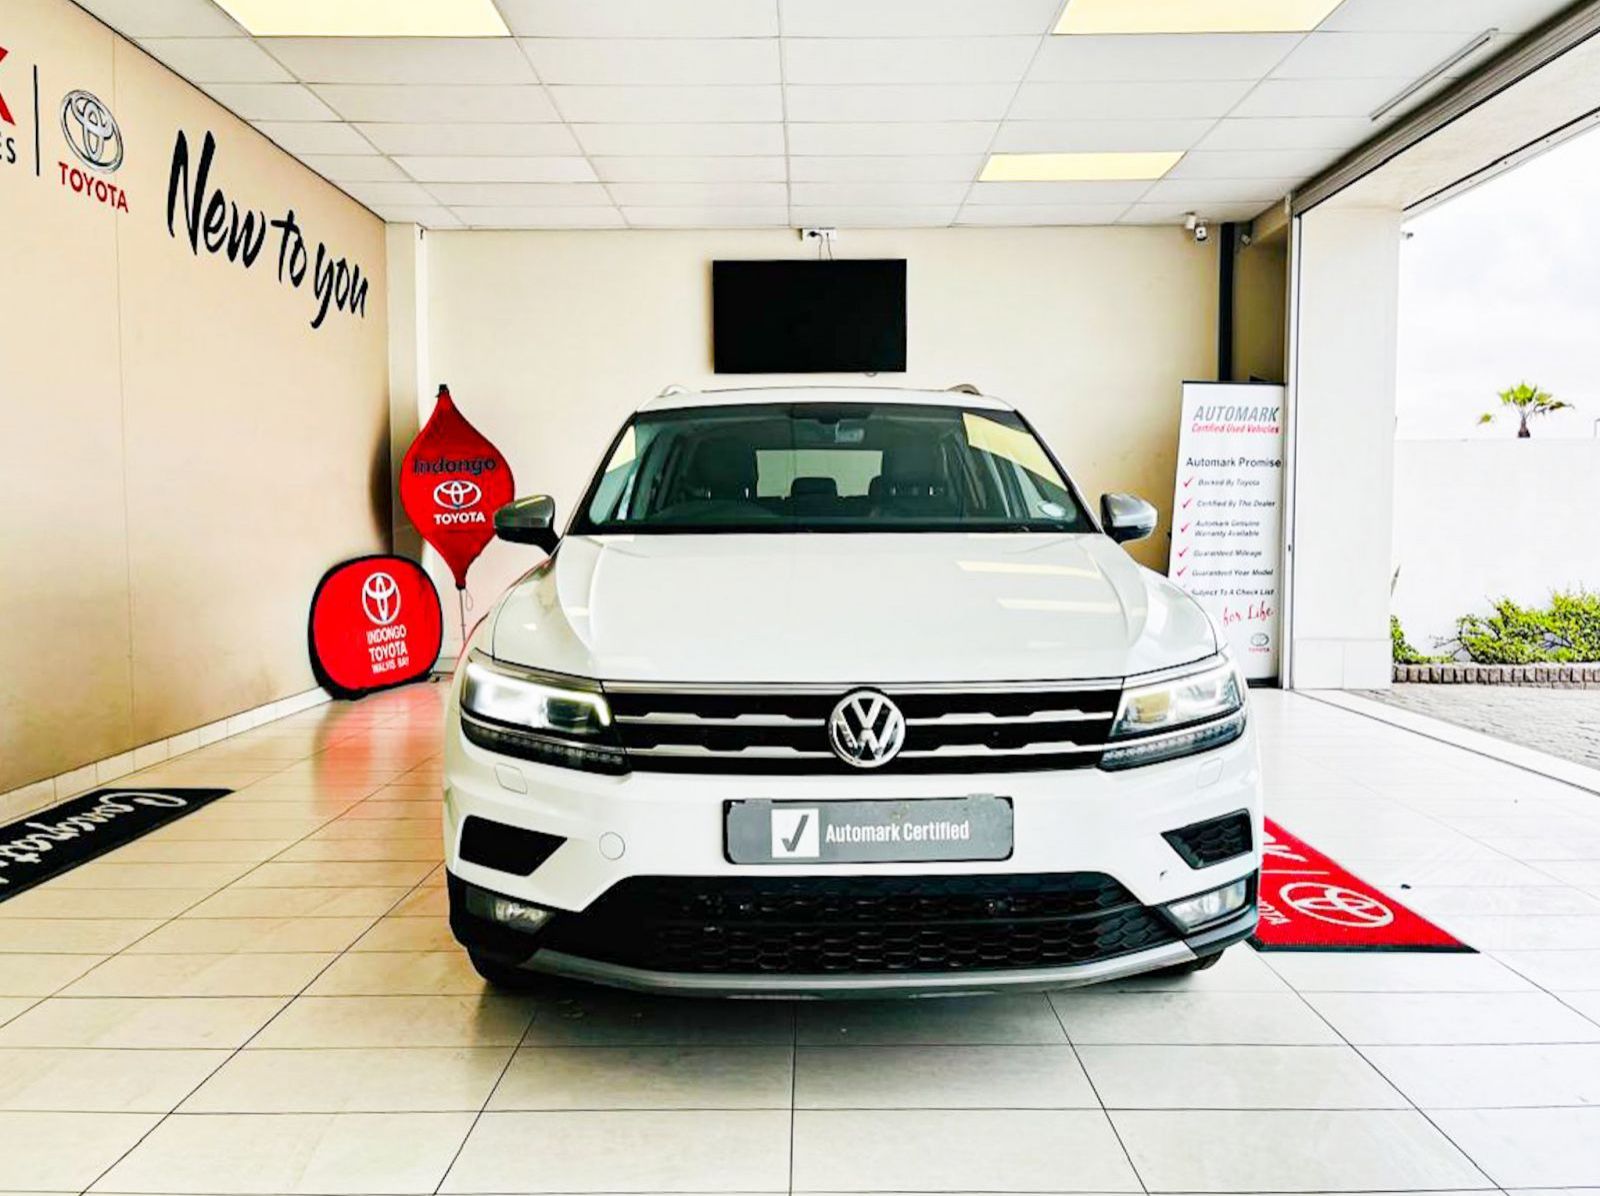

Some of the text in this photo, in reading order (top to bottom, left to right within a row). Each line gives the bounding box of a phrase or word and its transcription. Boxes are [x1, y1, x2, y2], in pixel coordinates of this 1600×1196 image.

[58, 161, 129, 213] TOYOTA
[166, 129, 369, 329] New to you
[1194, 406, 1279, 422] AUTOMARK
[1191, 423, 1280, 435] Certified Used Vehicles
[414, 457, 497, 476] Indongo
[1186, 457, 1282, 468] Automark Promise
[433, 511, 486, 525] TOYOTA
[366, 624, 407, 645] INDONGO
[369, 640, 408, 662] TOYOTA
[825, 820, 970, 844] Automark Certified
